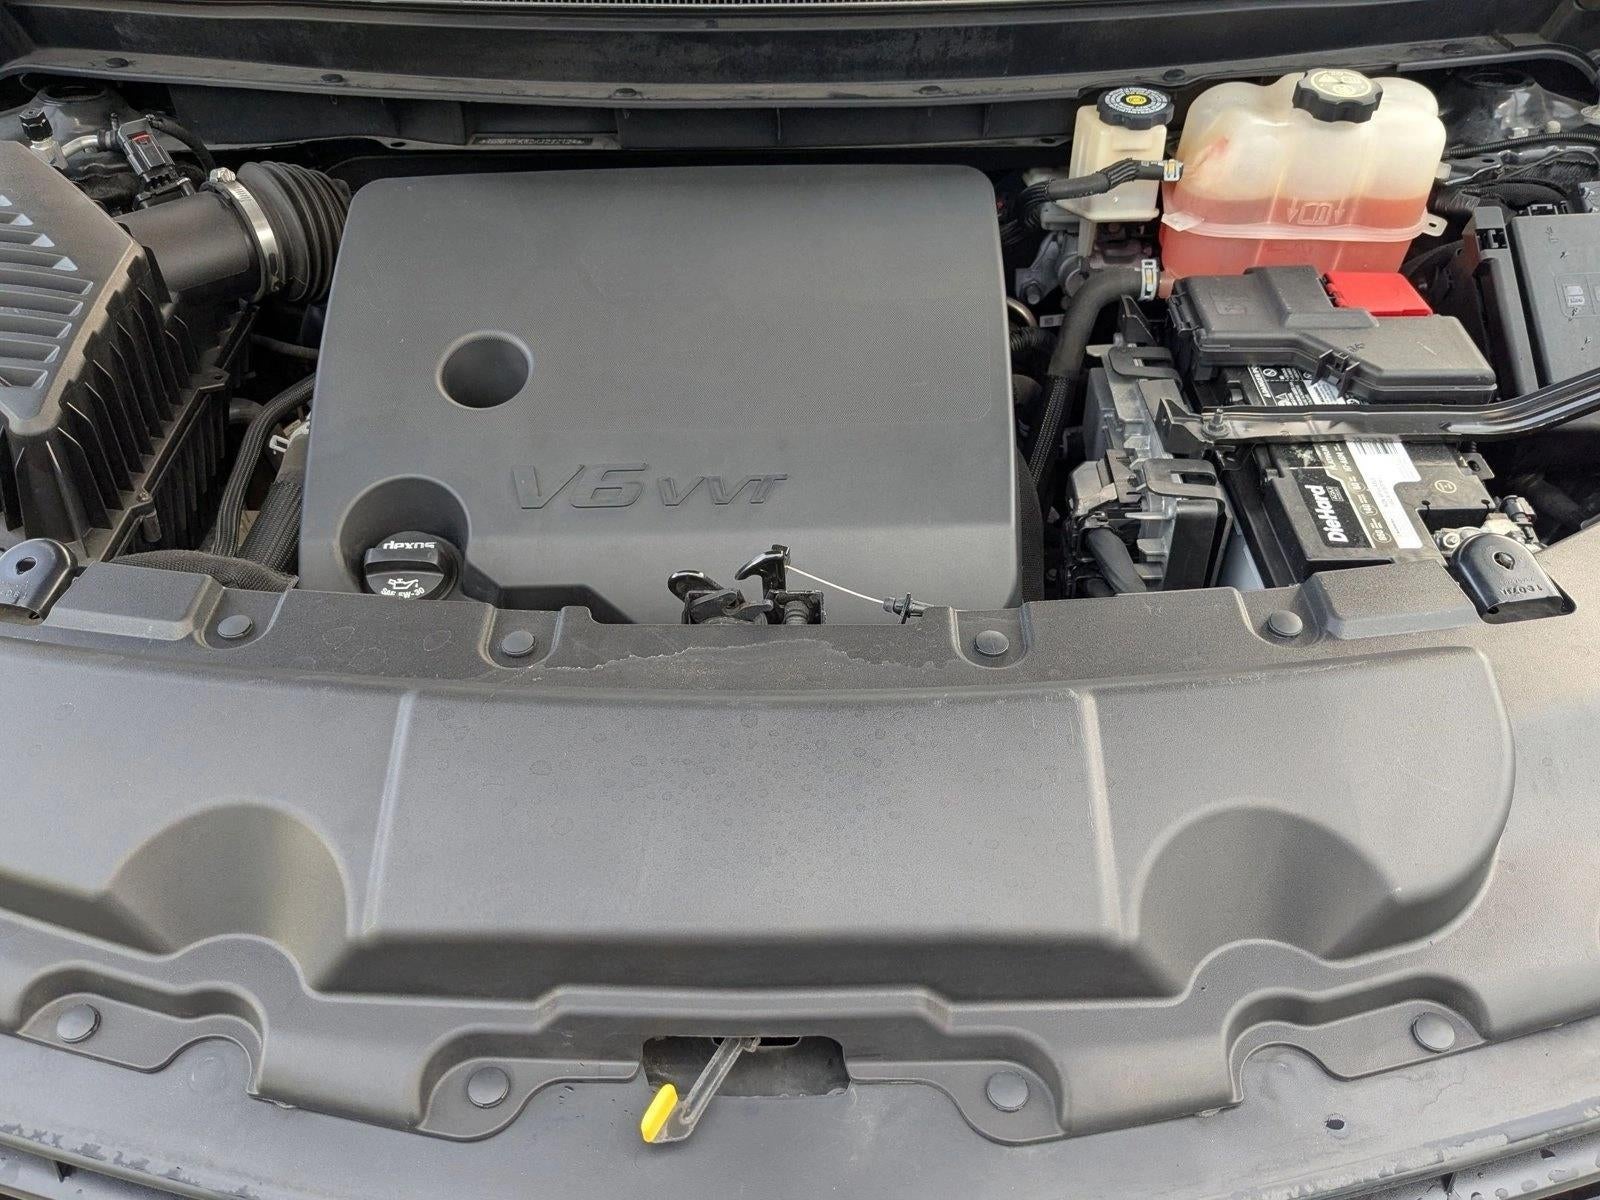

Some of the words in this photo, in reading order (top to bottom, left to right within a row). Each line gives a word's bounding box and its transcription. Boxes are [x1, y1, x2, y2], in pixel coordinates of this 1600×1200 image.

[511, 463, 648, 509] V6
[656, 474, 789, 505] VVT
[1304, 484, 1349, 543] DieHard
